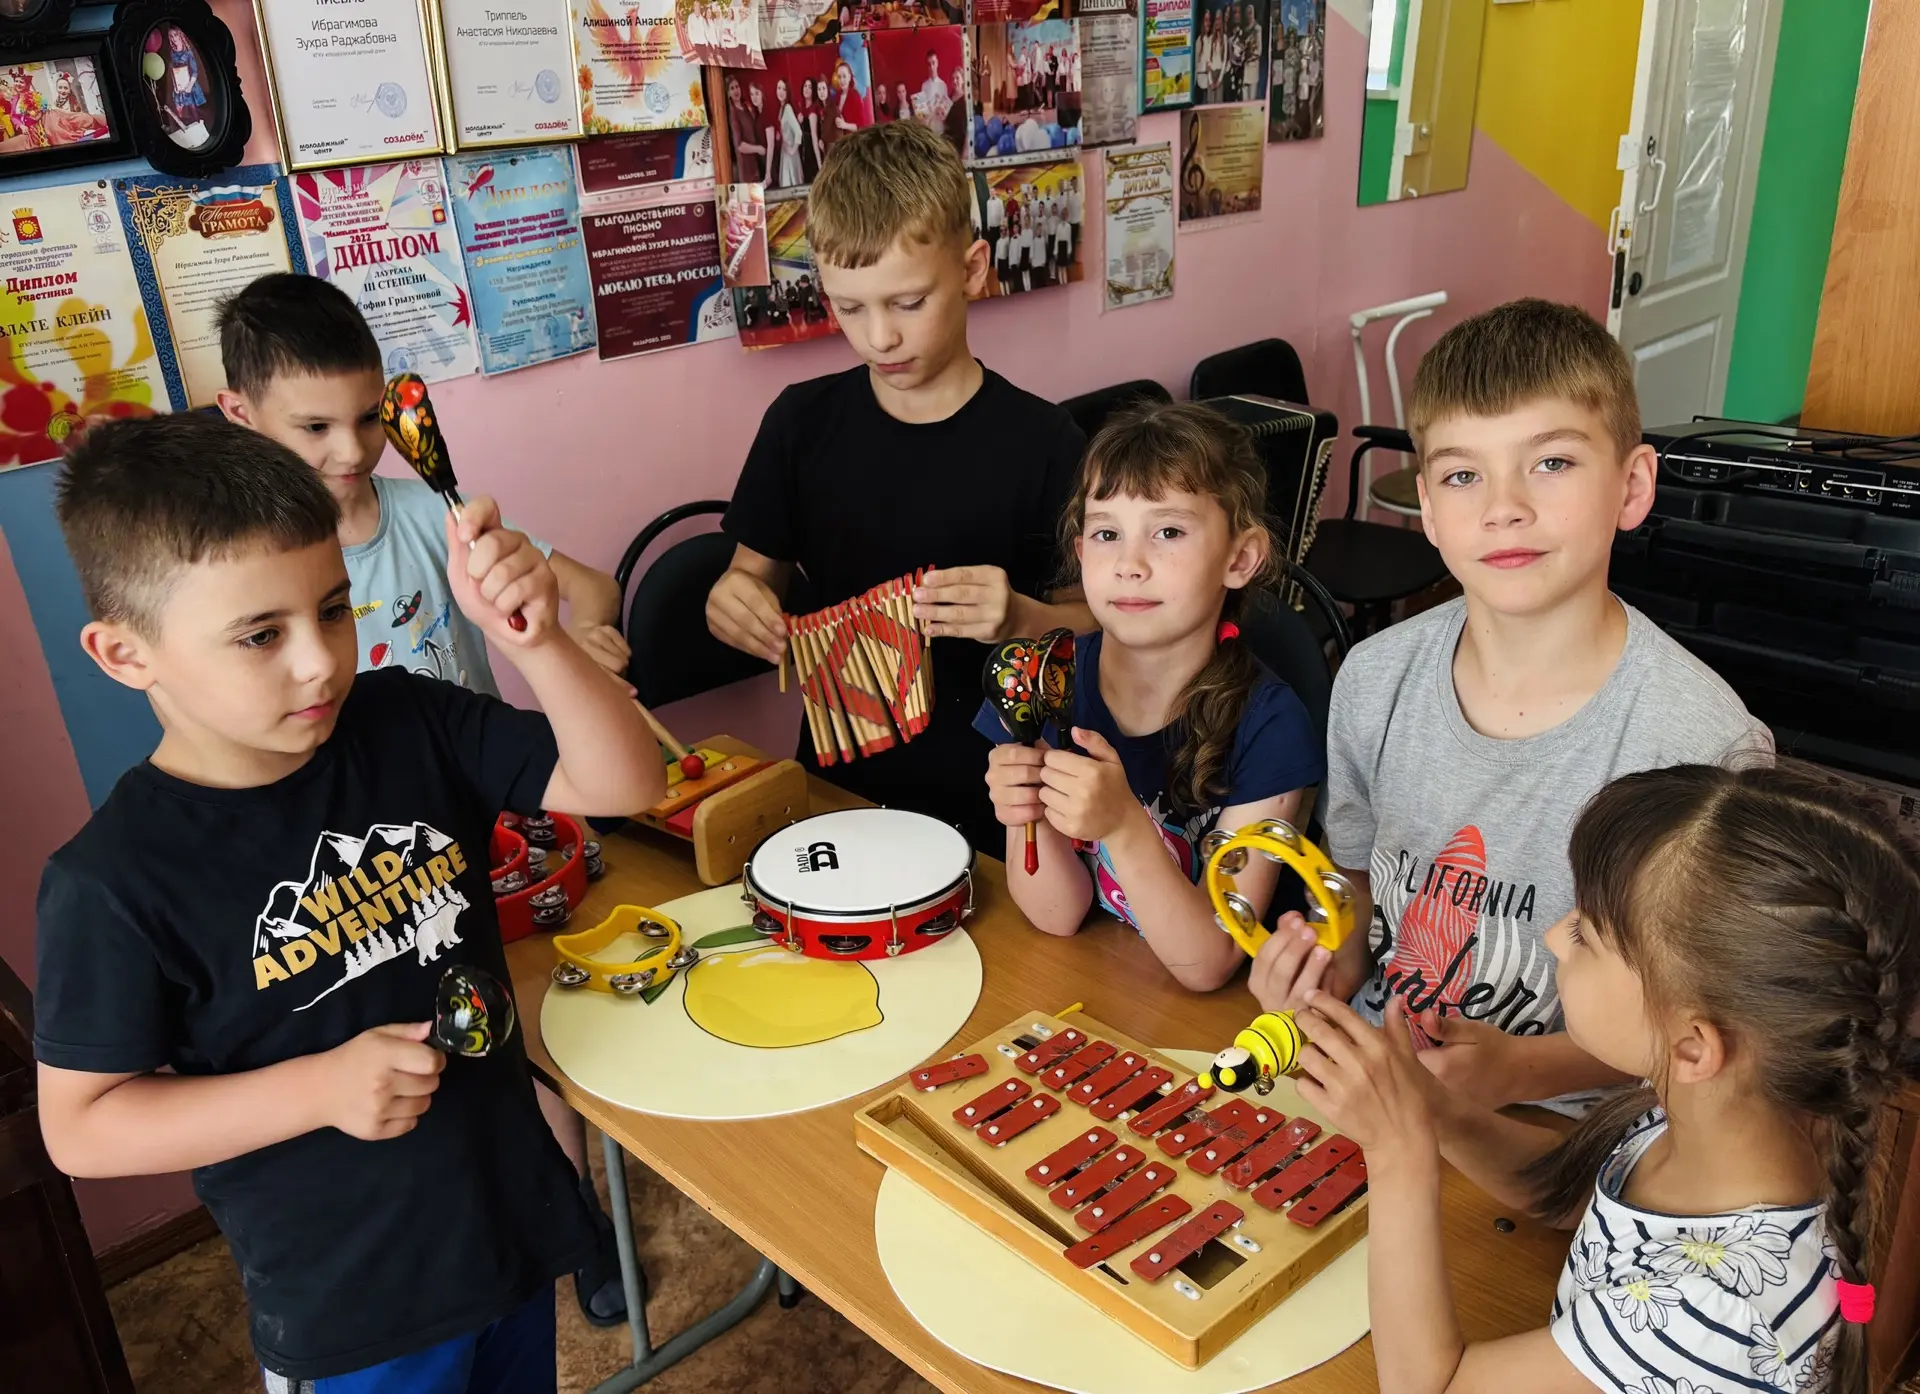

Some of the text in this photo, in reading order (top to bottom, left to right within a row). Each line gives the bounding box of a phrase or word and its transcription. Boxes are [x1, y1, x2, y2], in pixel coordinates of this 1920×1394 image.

[312, 18, 378, 32] Ибрагимова
[485, 10, 527, 22] Триппель
[583, 16, 632, 27] Алишиной
[457, 25, 558, 37] Анастасия Николаевна
[296, 32, 397, 50] Зухра Раджабовна
[199, 202, 260, 223] Почетная
[594, 206, 686, 228] БЛАГОДАРСТВЕННОЕ
[201, 216, 265, 233] ГРАМОТА
[623, 220, 662, 235] ПИСЬМО
[350, 233, 371, 244] 2022
[592, 241, 648, 259] ИБРАГИМОВОЙ
[648, 239, 670, 250] ЗУХРЕ
[671, 233, 716, 247] РАДЖАБОВНЕ
[334, 232, 440, 275] ДИПЛОМ
[374, 266, 413, 279] ЛАУРЕАТА
[598, 265, 722, 296] ЛЮБЛЮ ТЕБЯ, РОССИЯ
[6, 272, 78, 295] Диплом
[364, 274, 427, 293] III СТЕПЕНИ
[17, 288, 73, 305] участника
[388, 289, 441, 306] Грызуновой
[512, 292, 556, 307] Руководитель
[56, 308, 112, 328] КЛЕЙН
[796, 853, 811, 873] DADI
[299, 850, 404, 924] WILD
[253, 842, 468, 990] ADVENTURE
